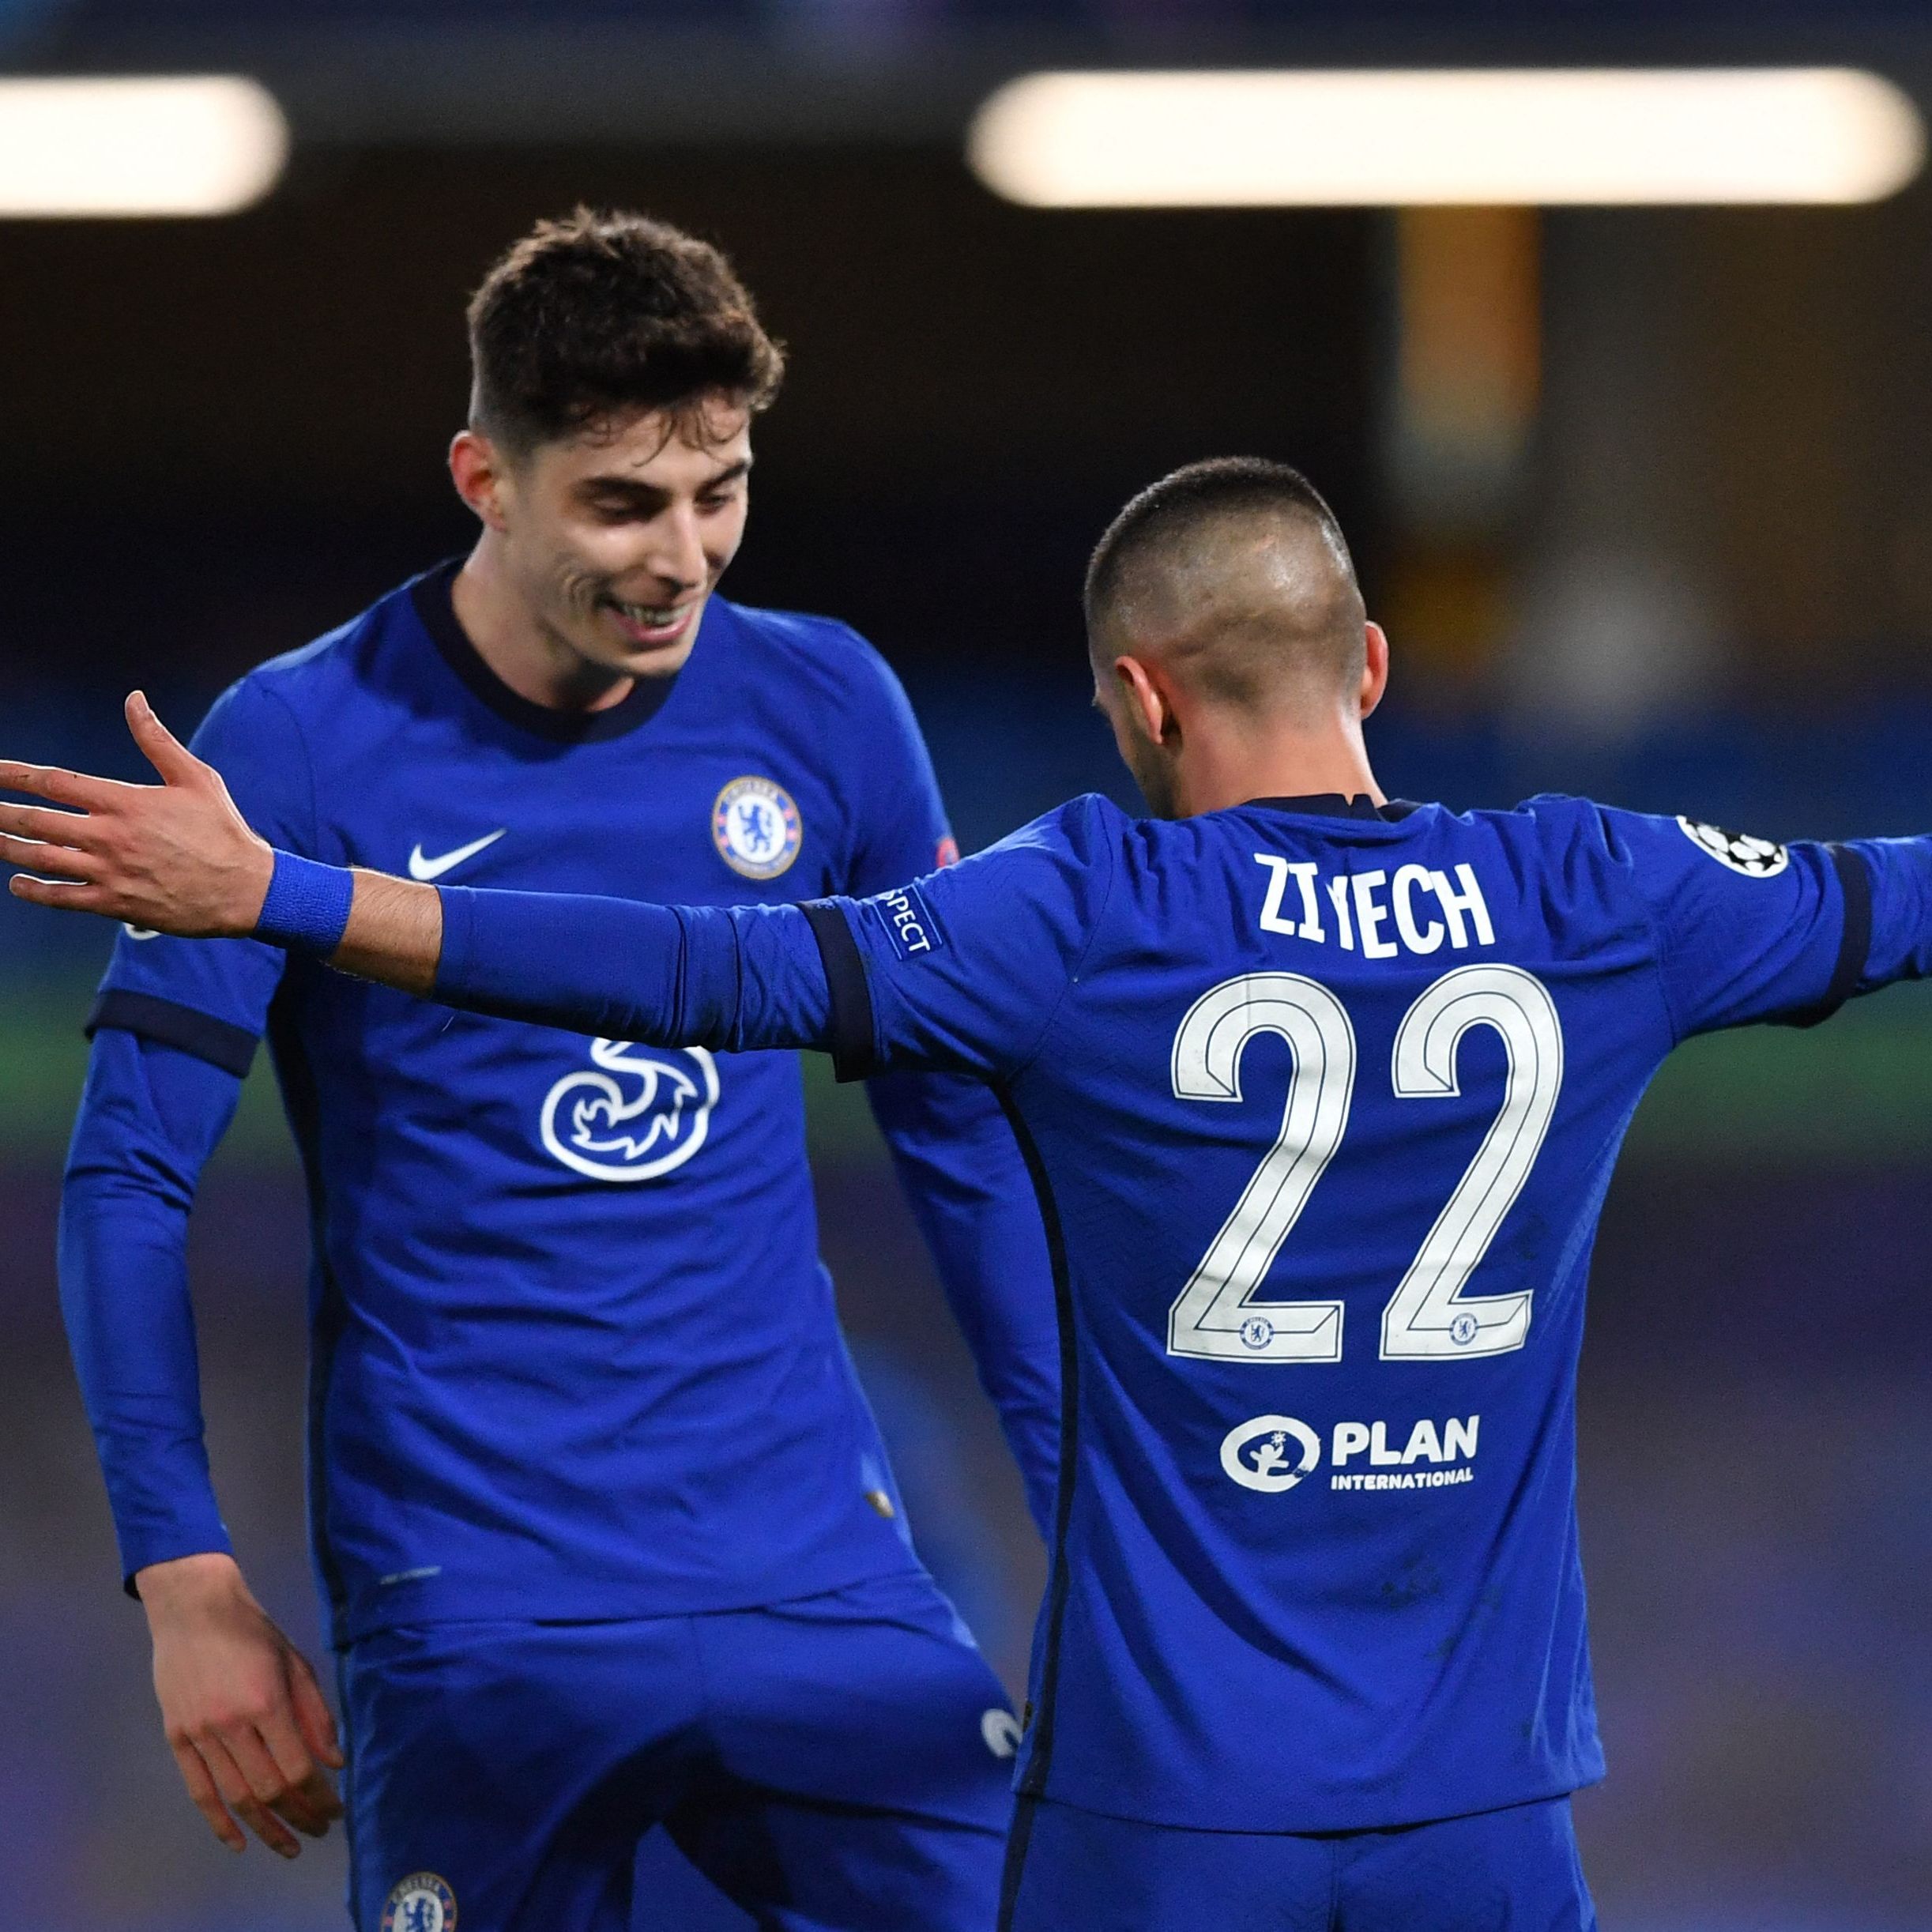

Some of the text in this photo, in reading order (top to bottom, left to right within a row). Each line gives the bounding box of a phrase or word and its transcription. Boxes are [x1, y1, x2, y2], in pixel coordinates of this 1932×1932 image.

[1253, 853, 1496, 959] ZIYECH
[1166, 962, 1564, 1363] 22
[1331, 1414, 1480, 1467] PLAN
[1331, 1467, 1474, 1490] INTERNATIONAL
